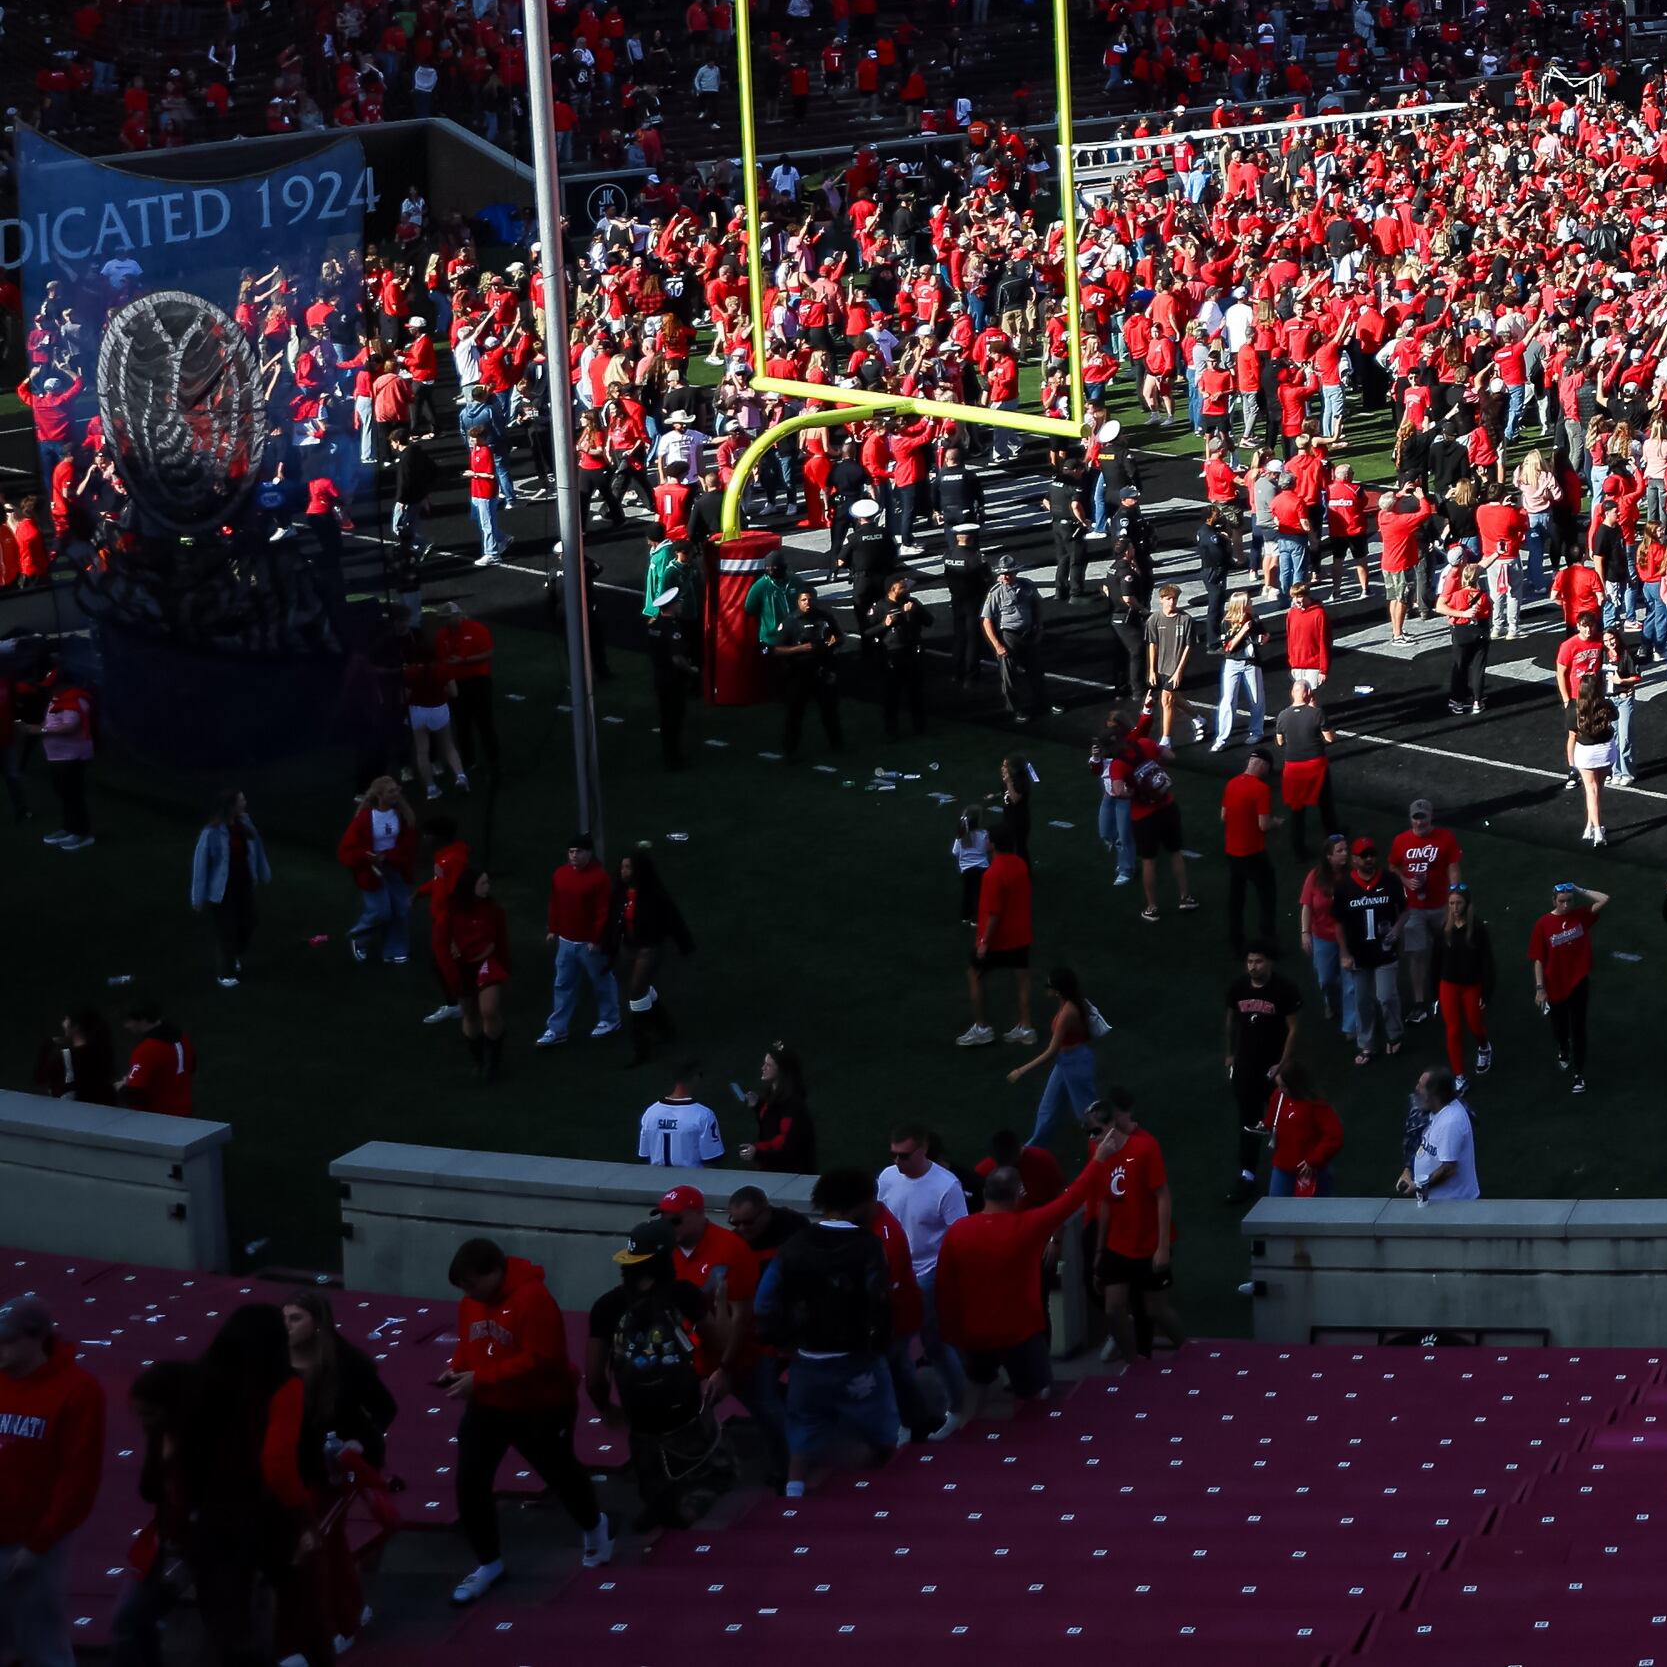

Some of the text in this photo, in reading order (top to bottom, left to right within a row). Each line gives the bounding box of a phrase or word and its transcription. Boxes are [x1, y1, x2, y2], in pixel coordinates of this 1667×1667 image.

[256, 166, 381, 229] 1924
[598, 189, 615, 204] JK
[1088, 291, 1106, 306] 45
[862, 533, 884, 542] POLICE
[945, 558, 965, 567] POLICE
[1406, 845, 1439, 862] CINCY
[1407, 862, 1429, 874] 513
[1349, 895, 1391, 908] CINCINNATI
[1365, 908, 1377, 942] 1
[658, 1118, 679, 1131] SAUCE
[663, 1132, 672, 1166] 1
